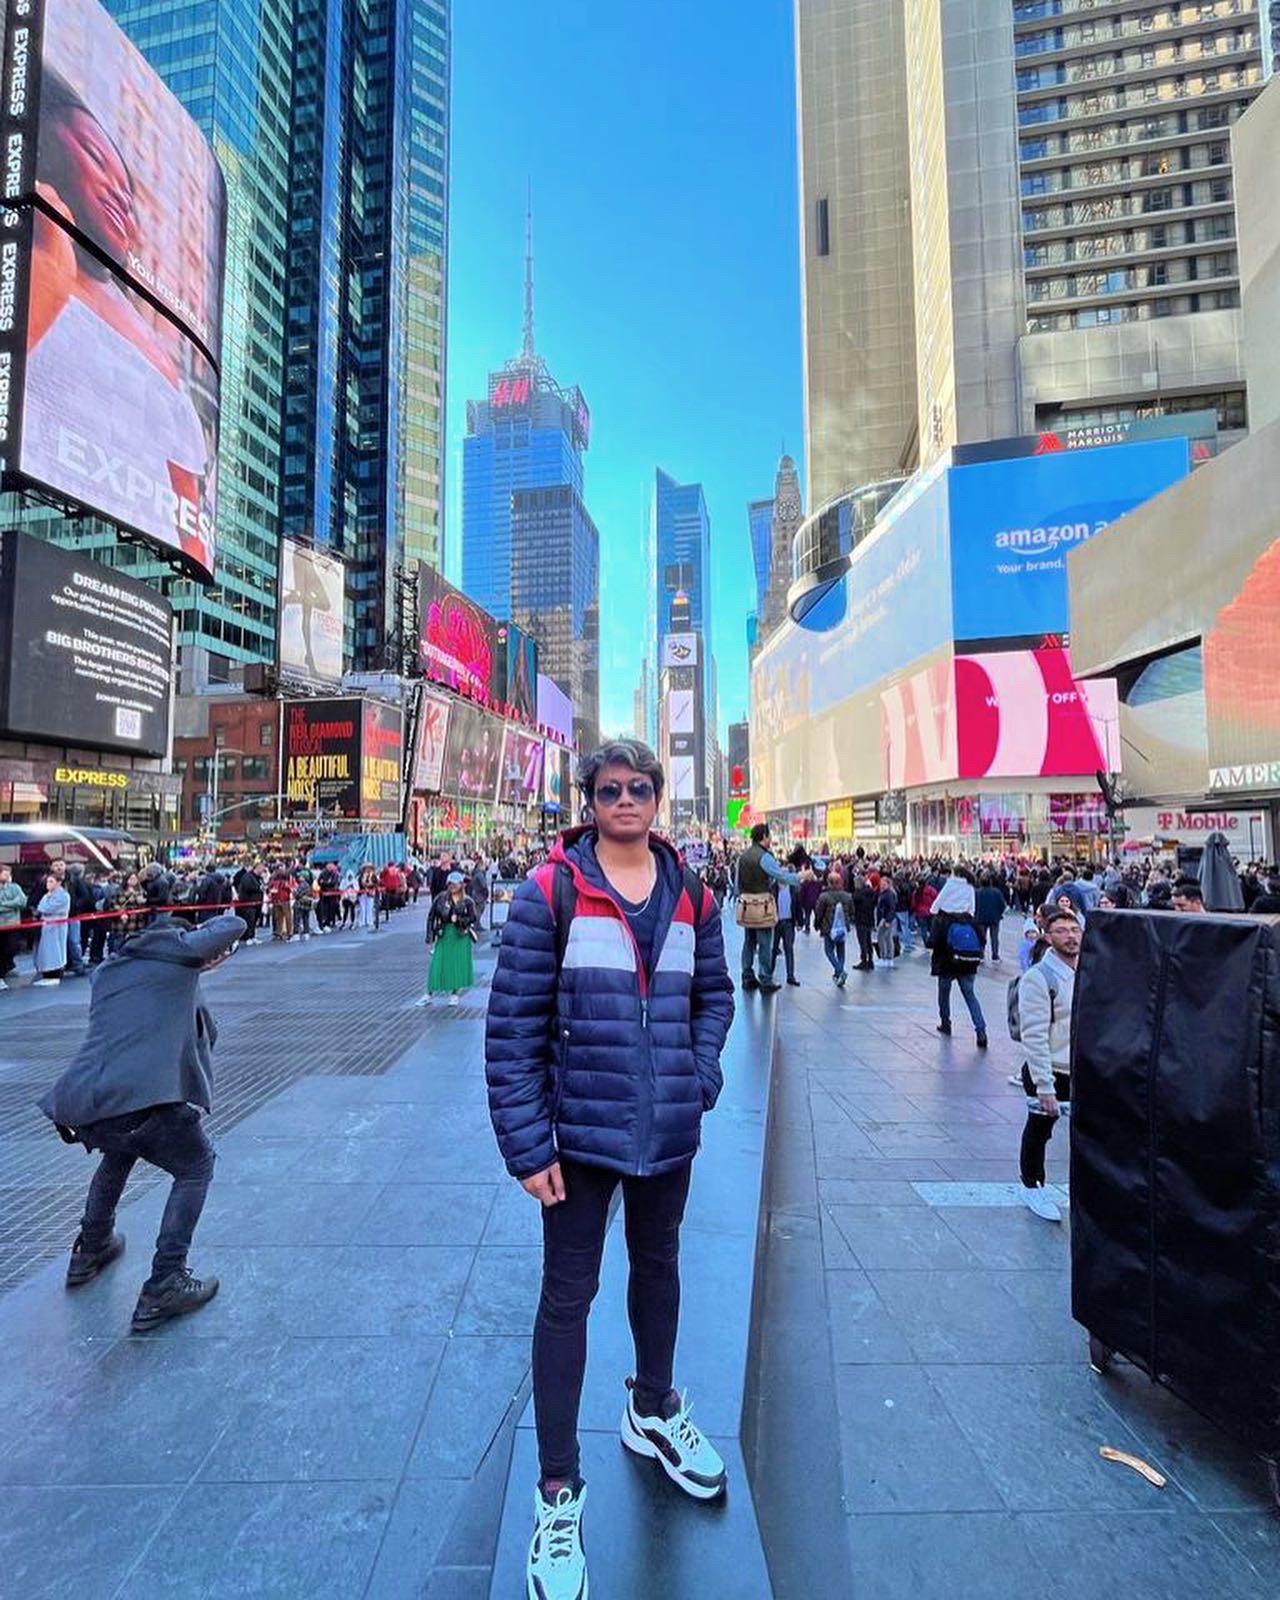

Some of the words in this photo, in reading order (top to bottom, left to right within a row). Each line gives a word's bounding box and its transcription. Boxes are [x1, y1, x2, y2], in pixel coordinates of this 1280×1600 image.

[10, 27, 29, 116] EXPRESS
[0, 242, 17, 332] EXPRESS
[1067, 423, 1129, 439] MARRIOTT
[1067, 434, 1123, 448] MARQUIS
[995, 522, 1089, 548] amazon
[997, 562, 1021, 574] Your
[73, 572, 121, 600] DREAM
[46, 630, 73, 648] BIG
[73, 639, 138, 667] BROTHERS
[1052, 692, 1077, 704] OFF
[288, 756, 295, 779] A
[296, 754, 350, 779] BEAUTIFUL
[54, 767, 129, 793] EXPRESS
[287, 778, 316, 802] NOISE
[1176, 811, 1239, 830] Mobile
